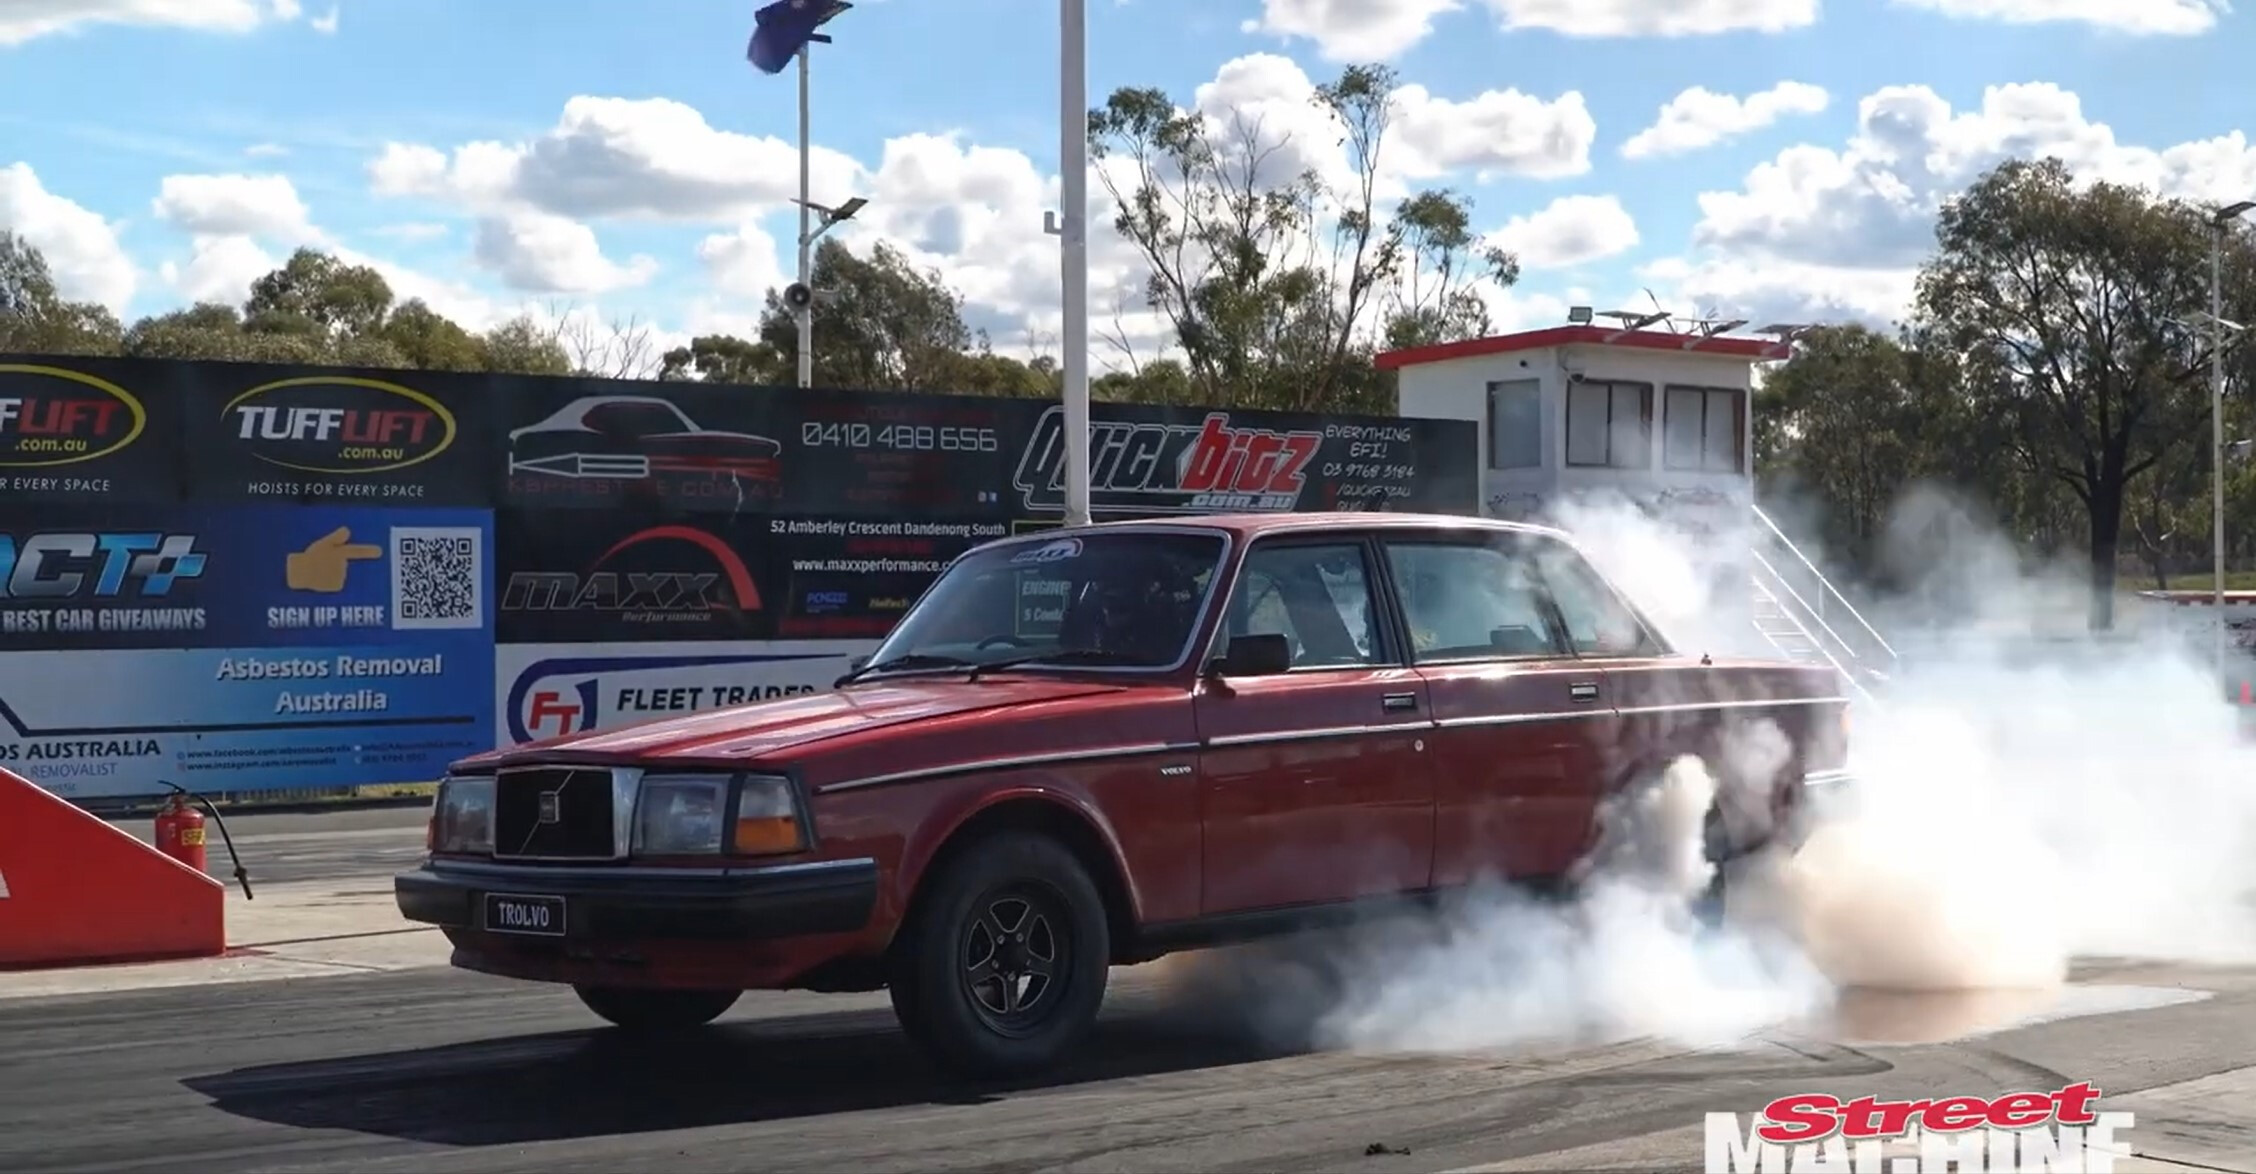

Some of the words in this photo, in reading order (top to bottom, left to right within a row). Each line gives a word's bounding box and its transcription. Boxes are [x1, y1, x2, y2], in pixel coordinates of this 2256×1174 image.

[236, 405, 433, 443] TUFFLIFT
[1326, 424, 1411, 442] EVERYTHING
[15, 438, 87, 452] .com.au
[802, 422, 870, 447] 0410
[877, 425, 934, 449] 488
[940, 427, 997, 451] 656
[338, 446, 404, 460] .com.au
[1350, 442, 1388, 458] EFI!
[1323, 462, 1342, 477] 03
[1346, 463, 1380, 478] 9768
[14, 478, 58, 490] EVERY
[64, 479, 110, 491] SPACE
[248, 482, 299, 495] HOISTS
[305, 483, 333, 495] FOR
[338, 484, 377, 496] EVERY
[383, 485, 424, 496] SPACE
[770, 520, 786, 533] 52
[788, 521, 846, 536] Amberley
[849, 521, 901, 534] Crescent
[904, 522, 970, 537] Dandenong
[972, 525, 1005, 536] South
[501, 572, 718, 610] MAXX
[3, 609, 51, 632] BEST
[55, 607, 94, 631] CAR
[98, 607, 206, 631] GIVEAWAYS
[267, 606, 310, 628] SIGN
[314, 606, 337, 628] UP
[341, 605, 385, 627] HERE
[622, 611, 712, 624] Performance
[216, 656, 329, 680] Asbestos
[336, 653, 442, 677] Removal
[275, 688, 387, 714] Australia
[617, 686, 702, 711] FLEET
[529, 692, 580, 735] FT
[26, 739, 161, 760] AUSTRALIA
[30, 762, 117, 778] REMOVALIST
[499, 903, 549, 927] TROLVO
